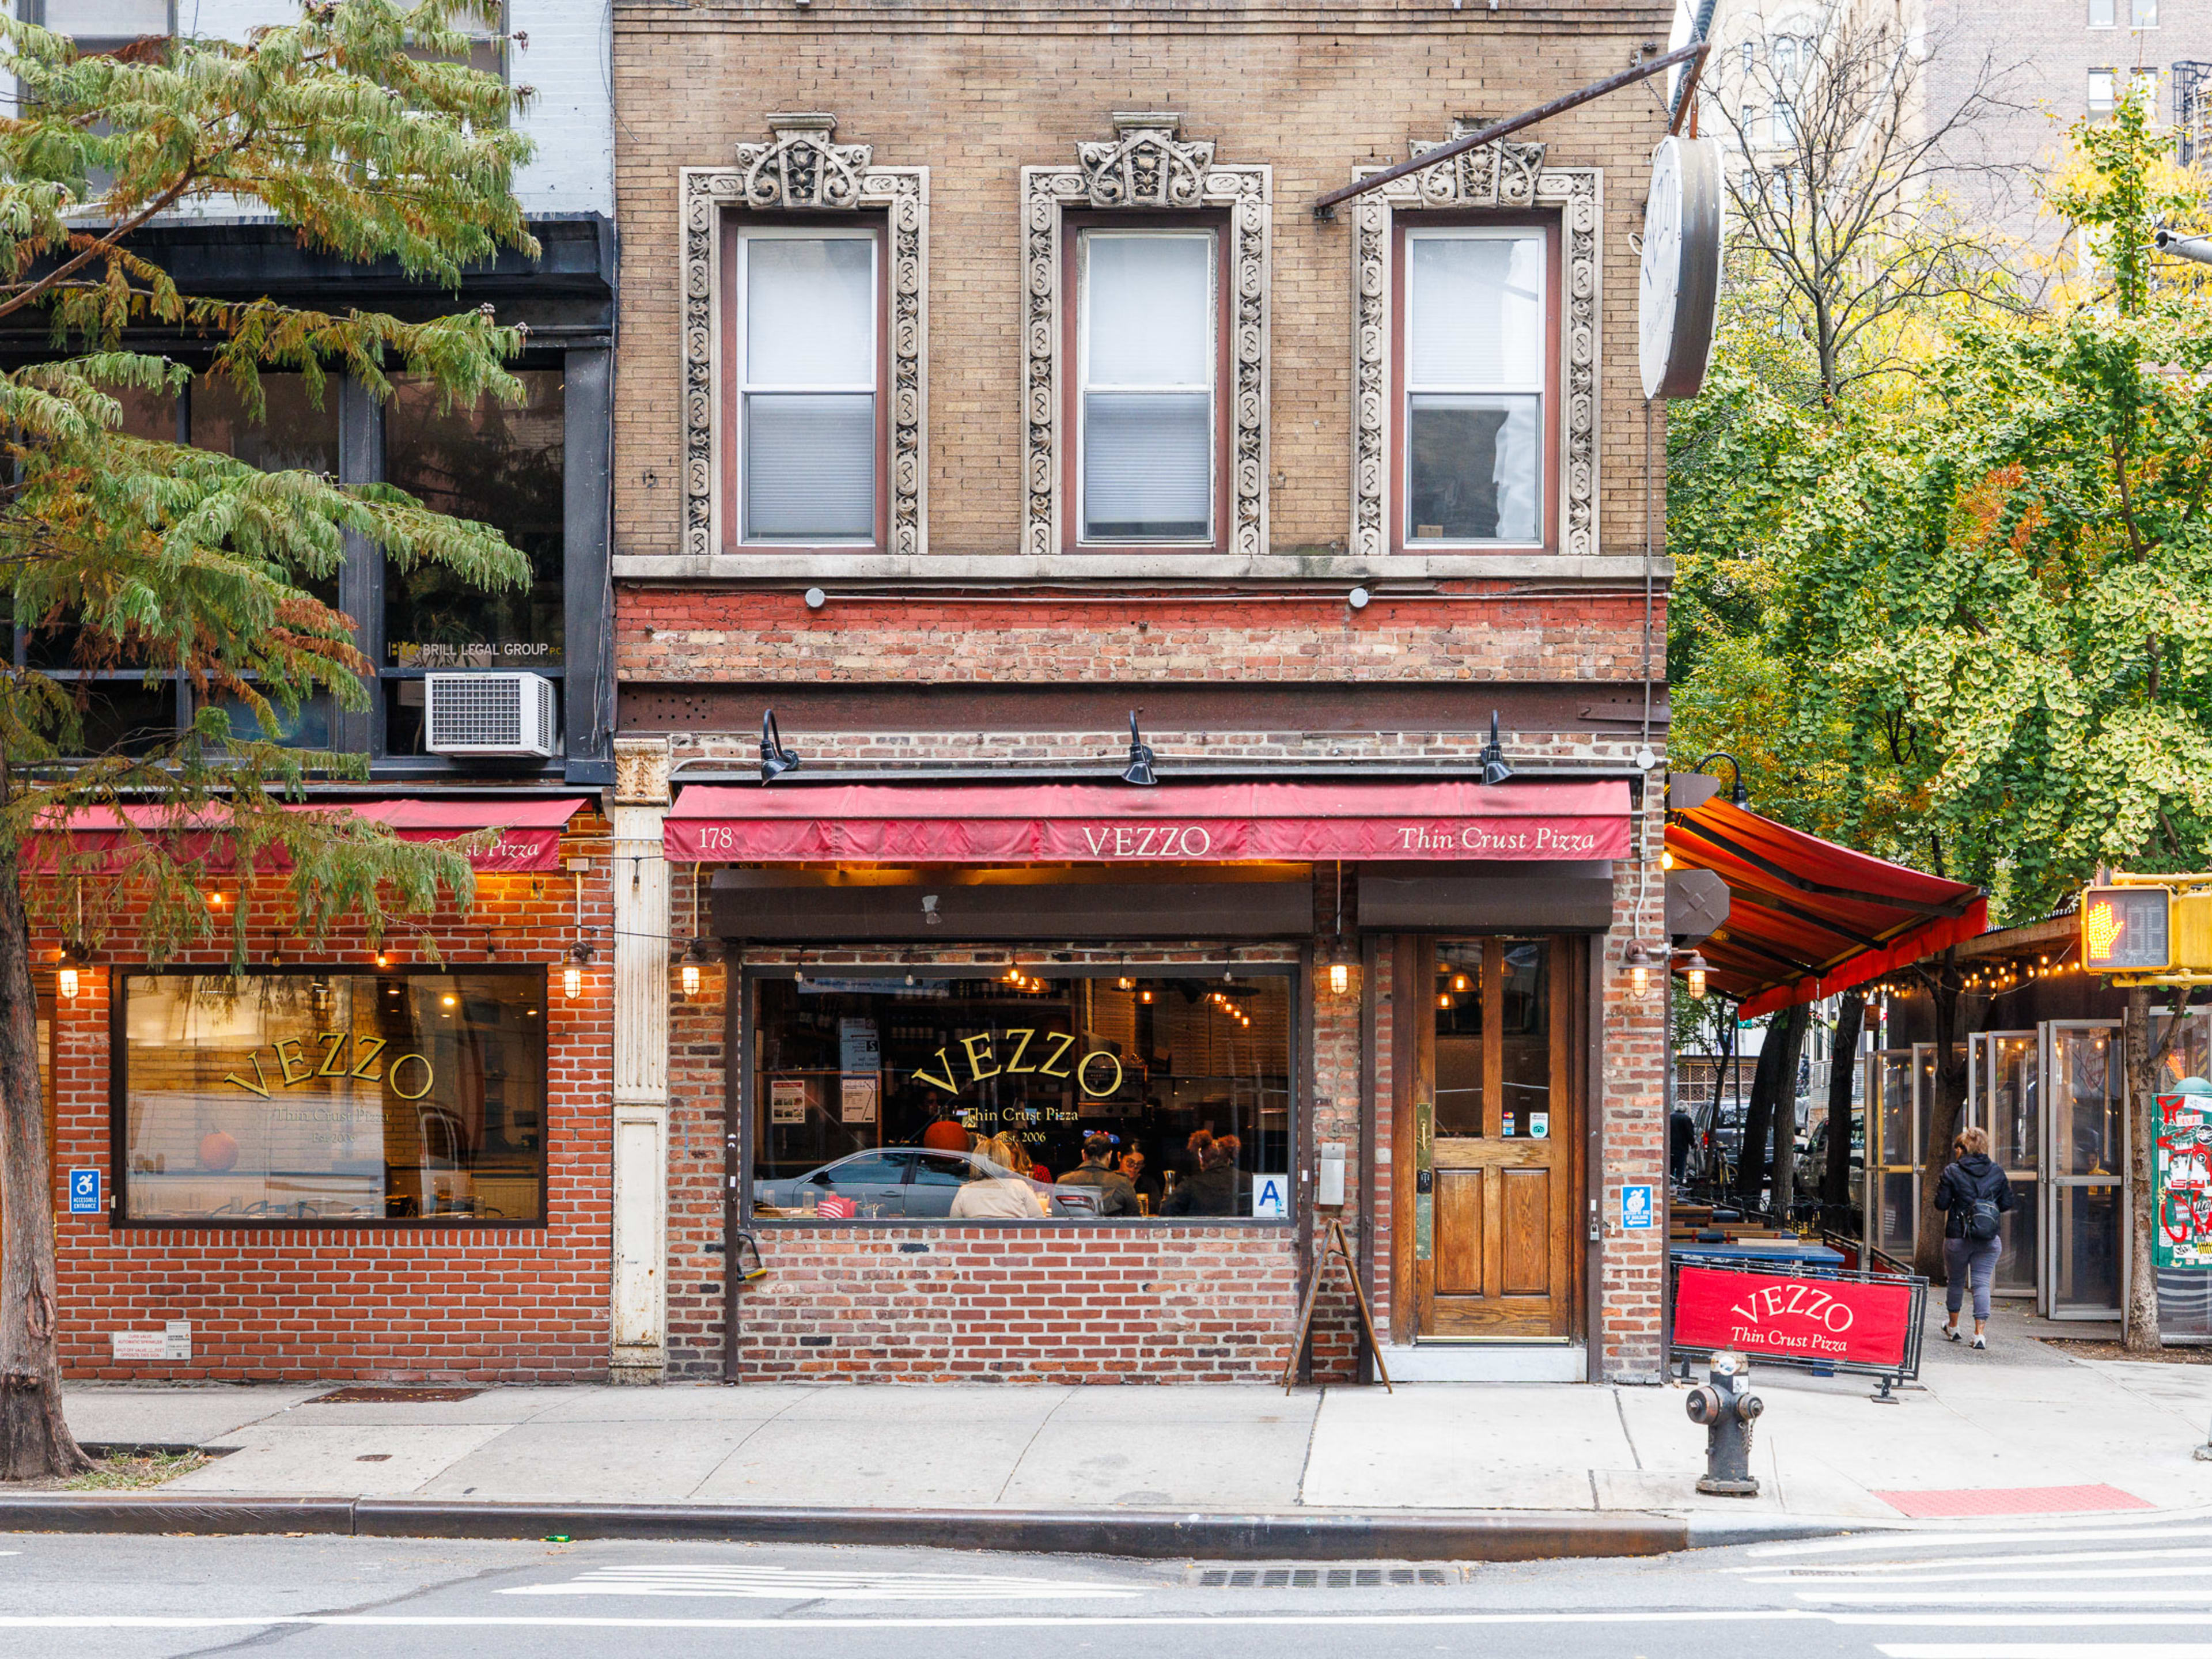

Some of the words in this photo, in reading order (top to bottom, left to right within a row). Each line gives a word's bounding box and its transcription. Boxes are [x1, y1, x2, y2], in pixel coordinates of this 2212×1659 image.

[422, 643, 457, 656] BRILL
[461, 643, 500, 656] LEGAL
[487, 837, 540, 858] Pizza
[699, 827, 733, 849] 178
[1082, 826, 1210, 857] VEZZO
[1398, 827, 1453, 849] Thin
[1462, 827, 1527, 849] Crust
[1535, 827, 1595, 851] Pizza
[224, 1032, 434, 1100] VEZZO
[911, 1028, 1123, 1097] VEZZO
[275, 1108, 309, 1122] Thin
[313, 1107, 352, 1123] Crust
[355, 1107, 389, 1123] Pizza
[964, 1107, 998, 1122] Thin
[1002, 1107, 1042, 1122] Crust
[1046, 1107, 1079, 1122] Pizza
[331, 1132, 357, 1143] 2006
[1002, 1132, 1019, 1143] Est.
[1021, 1131, 1046, 1143] 2006
[1258, 1180, 1280, 1207] A
[1730, 1284, 1854, 1332] VEZZO
[1731, 1326, 1765, 1343] Thin
[1768, 1330, 1808, 1348] Crust
[1811, 1334, 1848, 1353] Pizza
